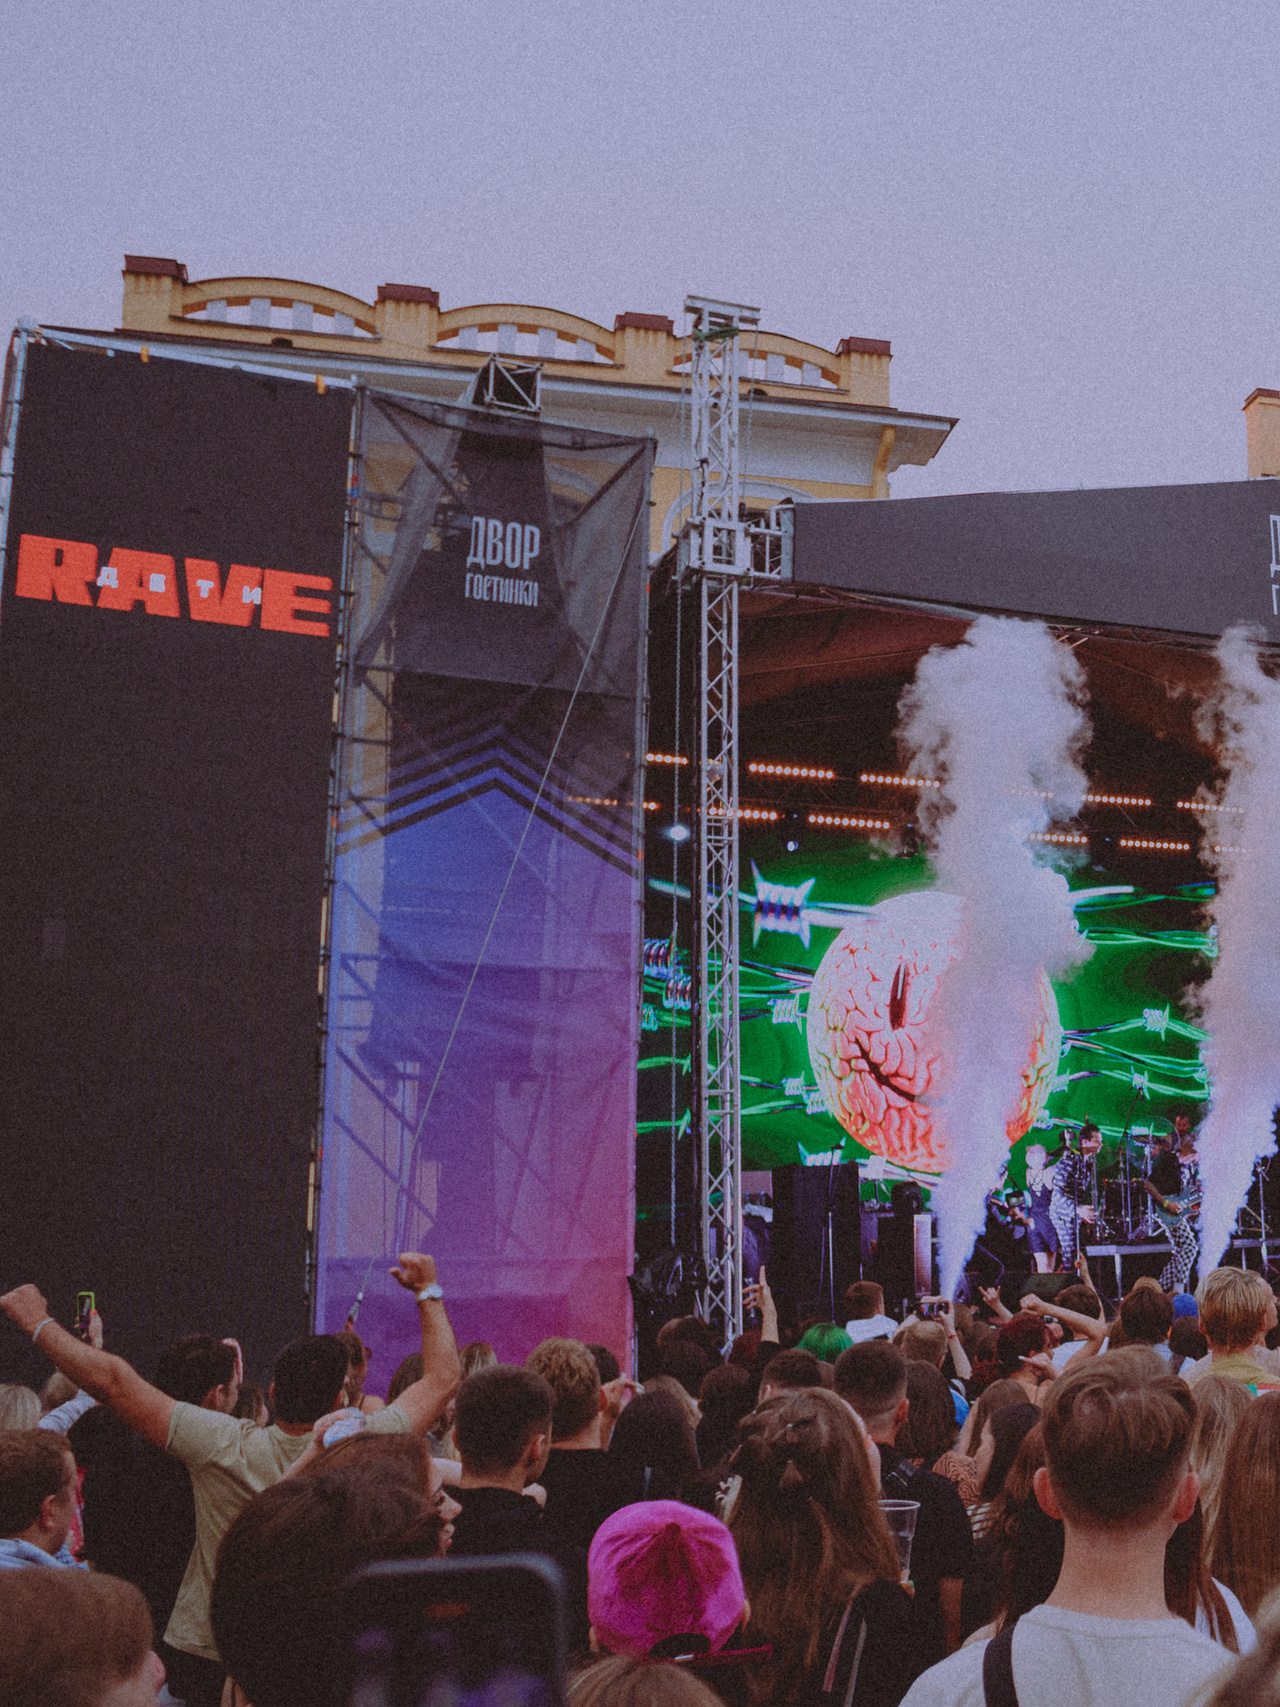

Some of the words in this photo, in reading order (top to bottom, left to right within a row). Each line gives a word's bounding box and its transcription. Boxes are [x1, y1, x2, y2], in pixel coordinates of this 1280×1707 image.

[466, 516, 540, 570] ДВОР
[15, 533, 333, 637] RAVE
[465, 572, 538, 607] ГОСТИНКИ
